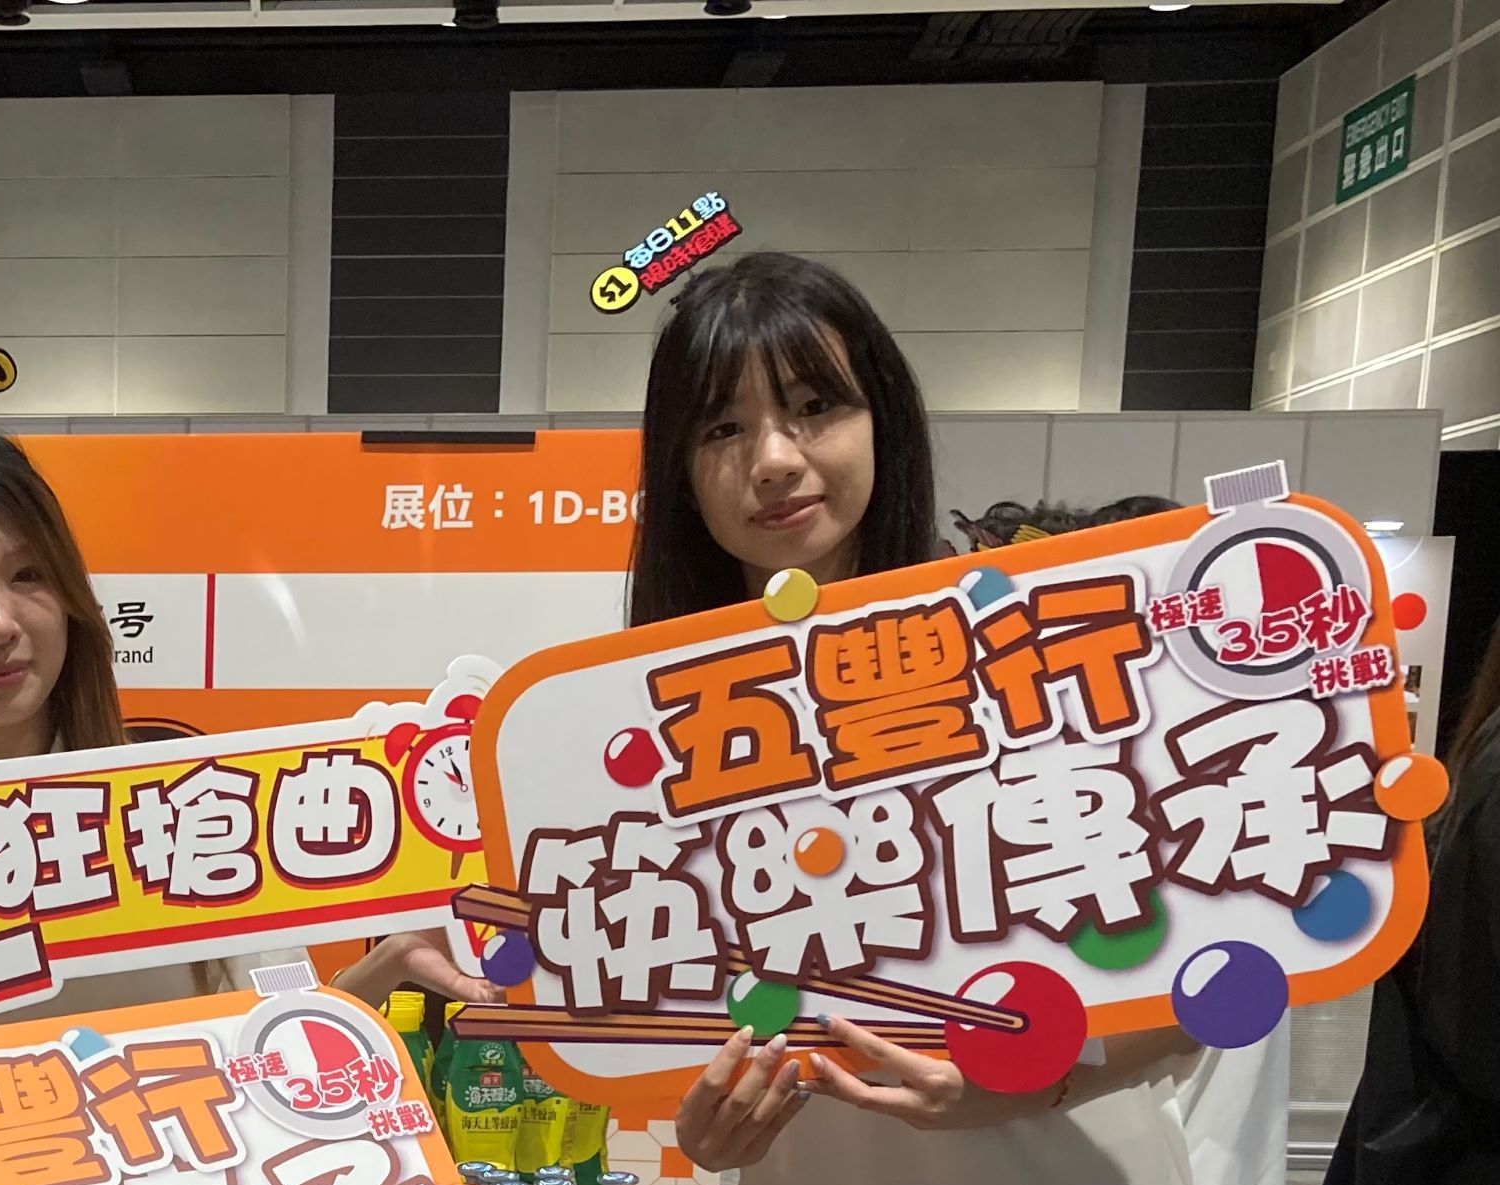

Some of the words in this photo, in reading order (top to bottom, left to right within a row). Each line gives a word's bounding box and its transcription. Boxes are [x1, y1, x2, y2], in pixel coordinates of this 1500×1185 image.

[1148, 588, 1224, 634] 極速
[1215, 586, 1371, 666] 35秒
[648, 575, 1154, 812] 五豐行
[1310, 648, 1392, 694] 挑戰
[439, 746, 454, 760] 12
[525, 706, 1394, 1011] 筷樂傳承
[227, 1053, 289, 1087] 極速
[286, 1054, 401, 1112] 35秒
[368, 1101, 432, 1138] 挑戰
